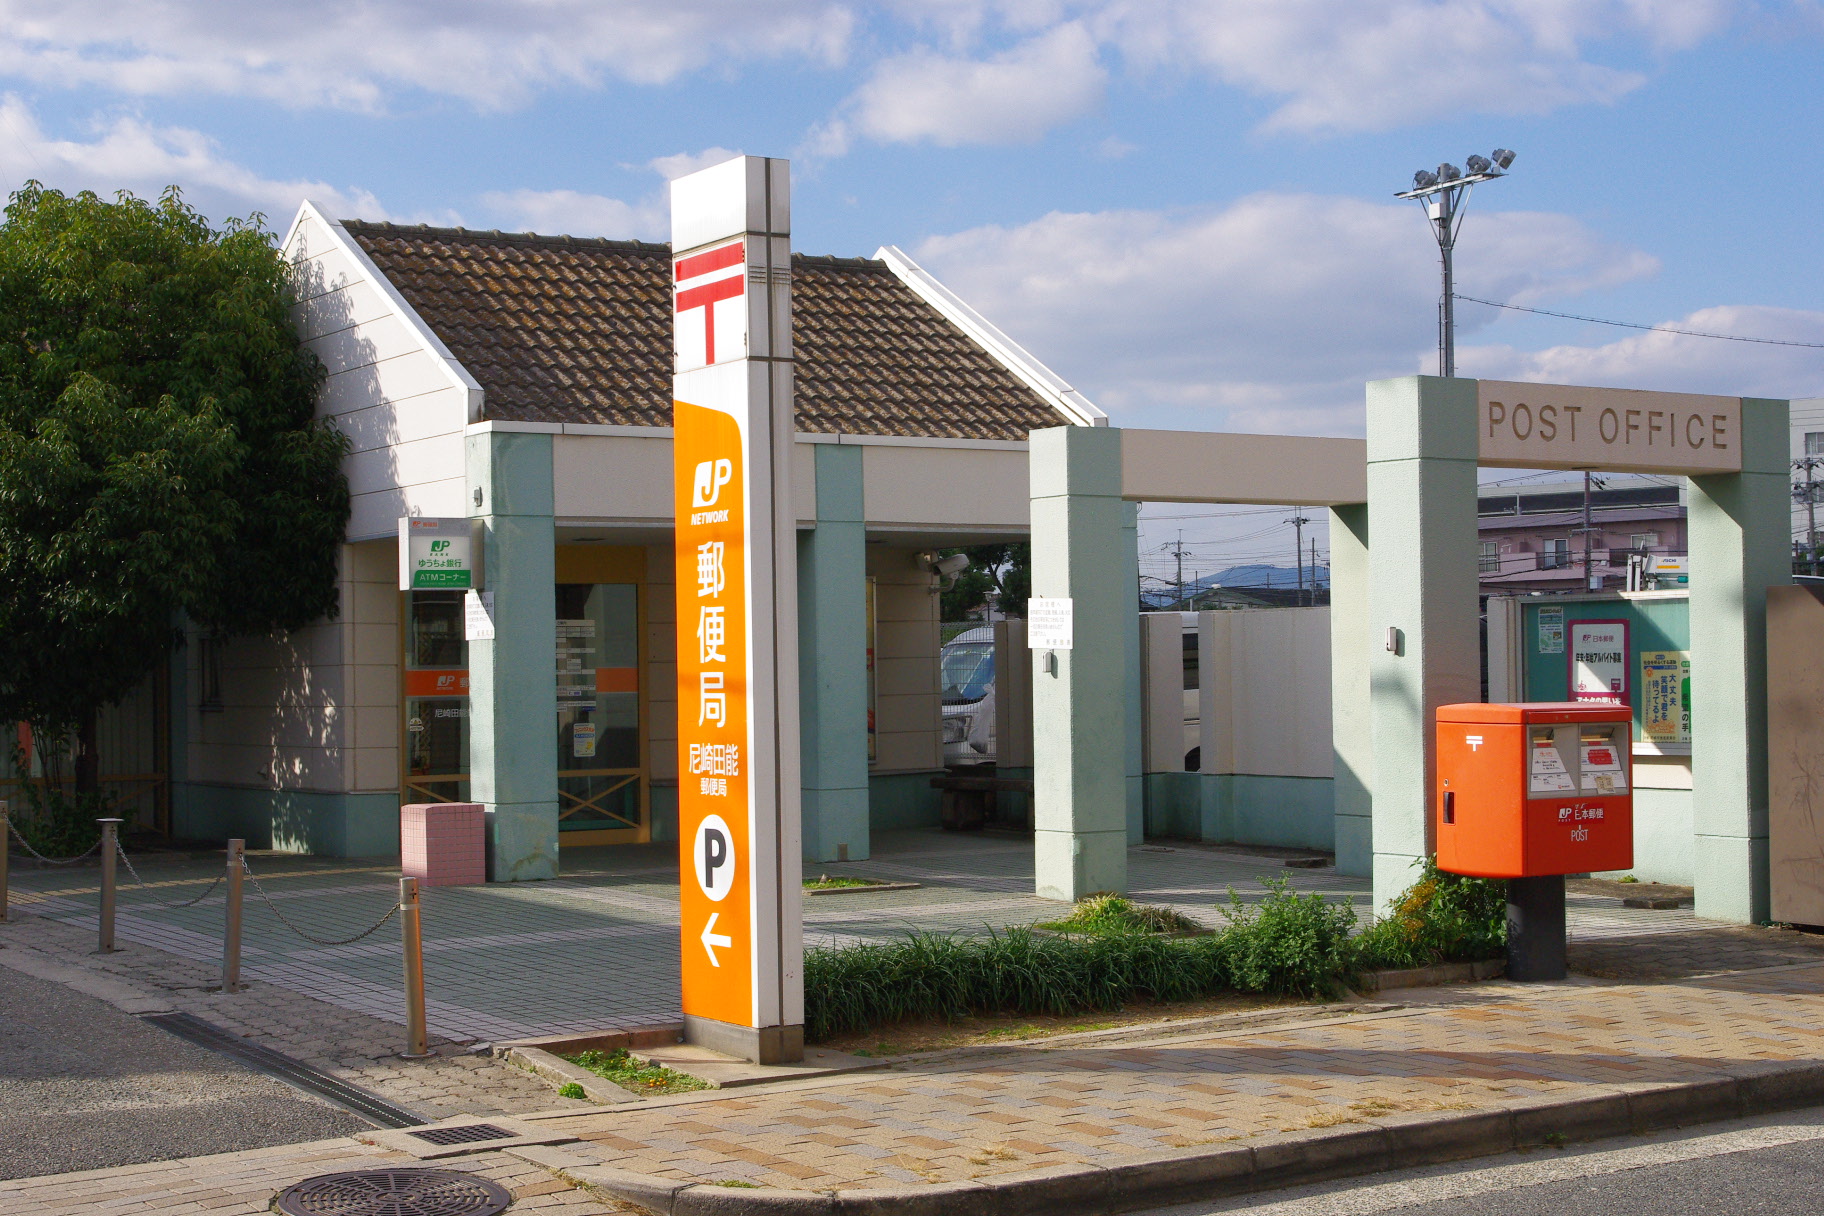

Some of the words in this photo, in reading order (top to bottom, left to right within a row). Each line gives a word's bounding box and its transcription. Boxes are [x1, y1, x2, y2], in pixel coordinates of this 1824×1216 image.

[1488, 401, 1582, 442] POST
[1599, 407, 1727, 450] OFFICE
[691, 509, 729, 526] NETWORK
[418, 559, 462, 568] ゆうちょ銀行
[420, 573, 466, 581] ATMコーナー
[697, 541, 726, 728] 郵便局
[1576, 652, 1621, 663] 年末・年始アルバイト募集
[1652, 679, 1660, 724] 待ってるよ
[1661, 675, 1669, 721] 笑顔で君を
[1669, 673, 1677, 706] 大丈夫
[689, 743, 739, 777] 尼崎田能
[700, 777, 727, 797] 郵便局
[1571, 829, 1588, 842] POST
[704, 828, 727, 889] P
